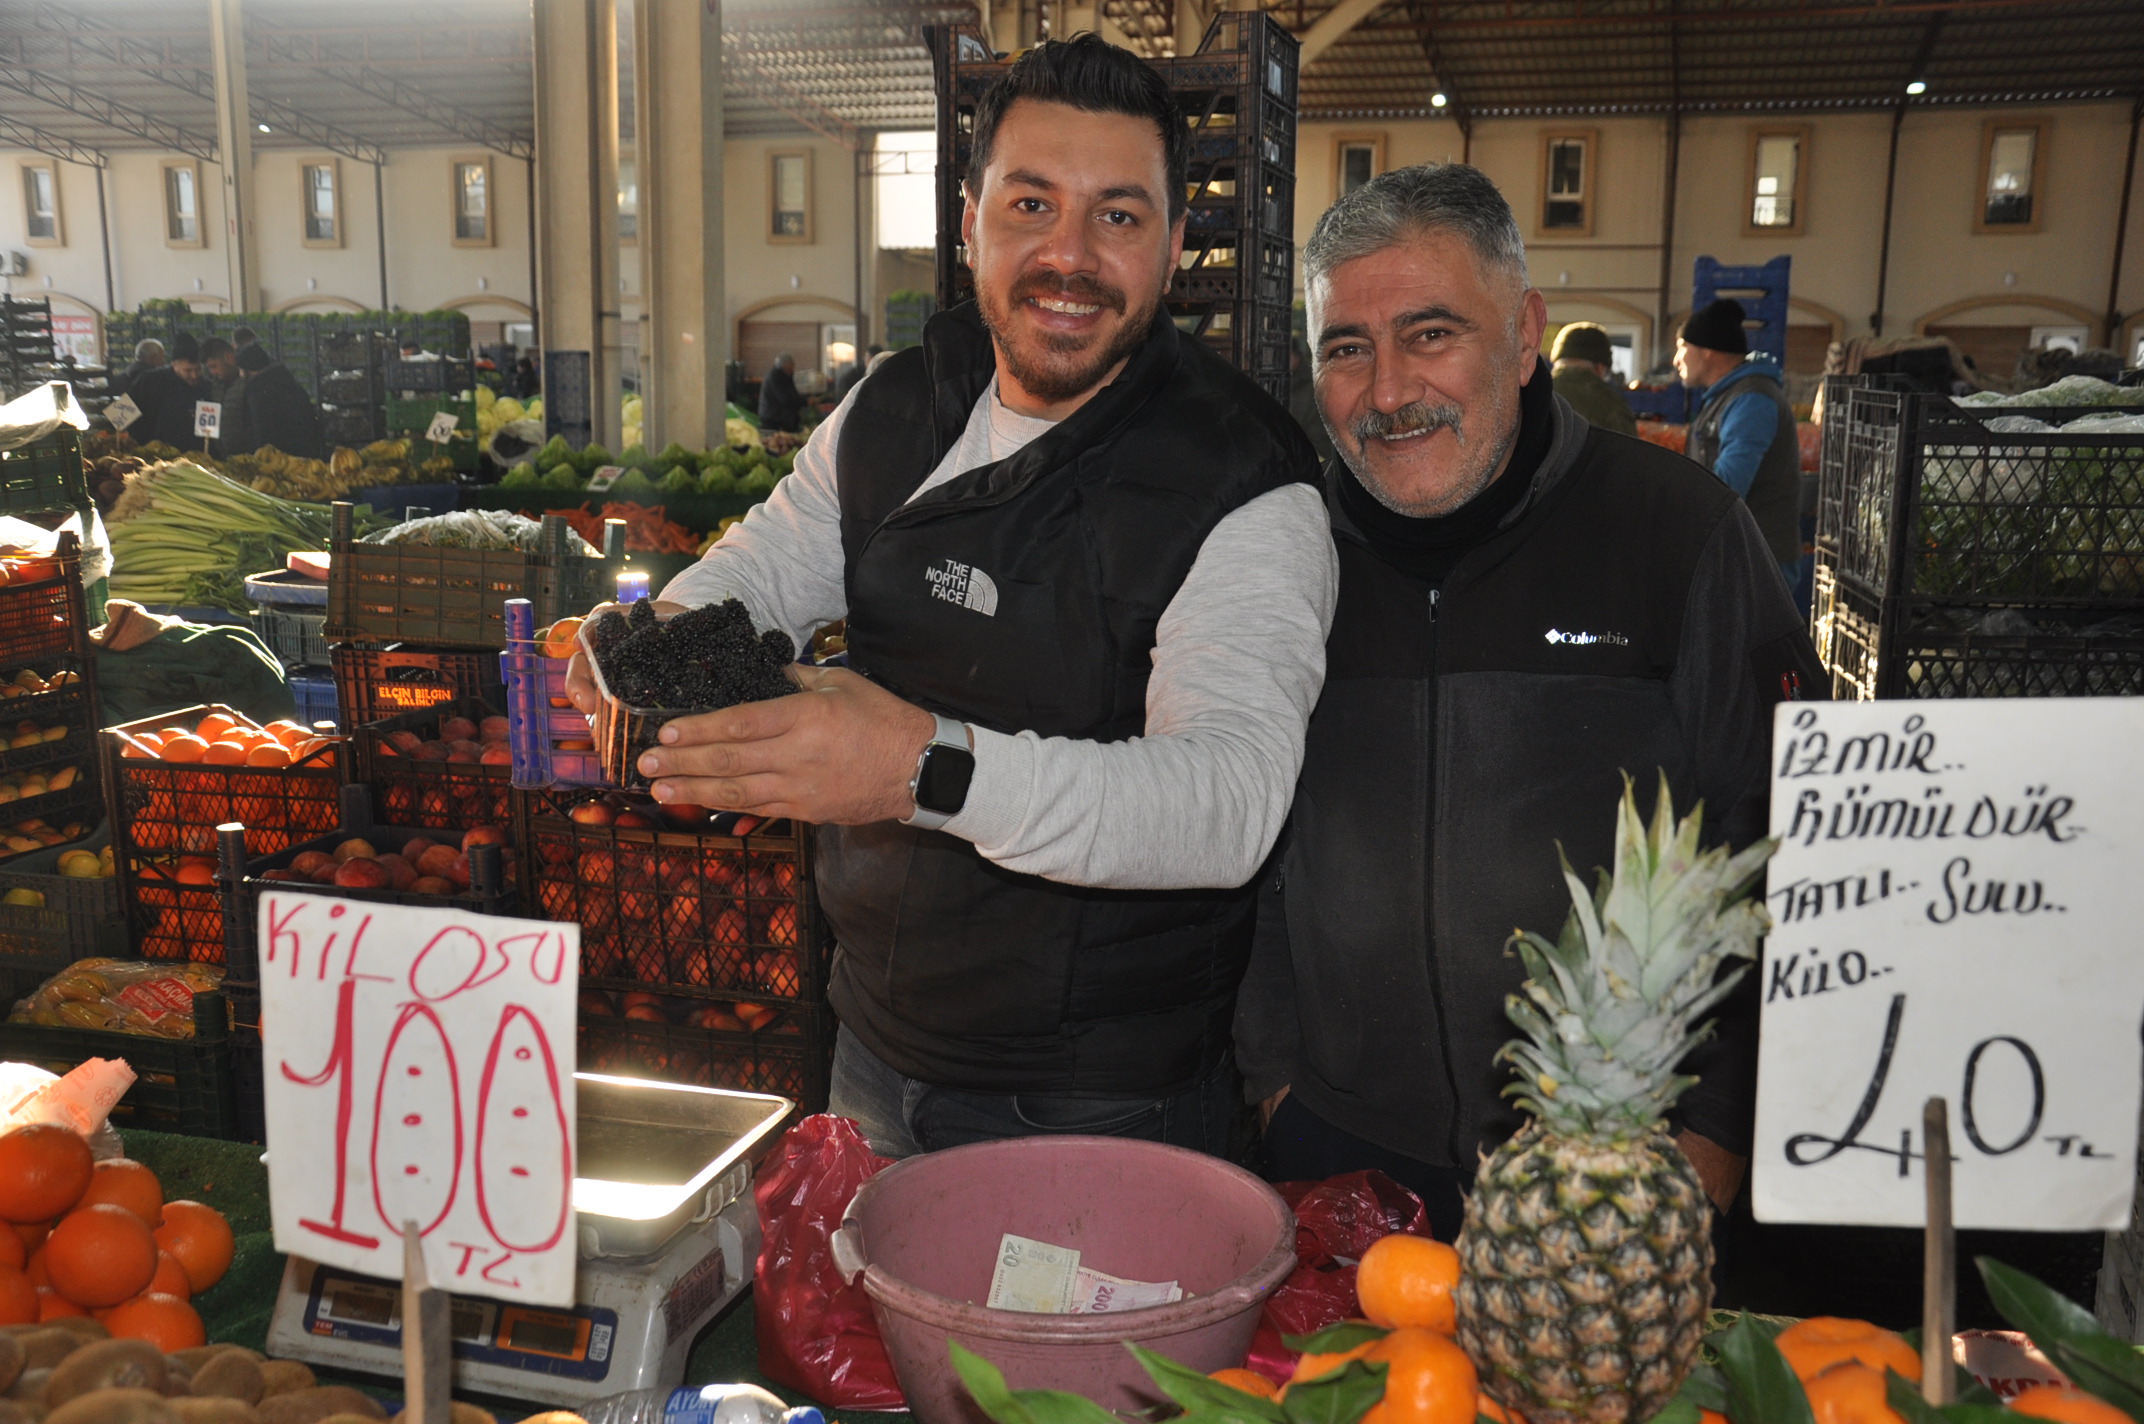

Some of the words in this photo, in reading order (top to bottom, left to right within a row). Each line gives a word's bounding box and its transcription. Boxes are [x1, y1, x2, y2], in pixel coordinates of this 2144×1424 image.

[924, 566, 967, 592] NORTH
[945, 559, 970, 578] THE
[931, 584, 965, 606] FACE
[1560, 631, 1629, 646] Columbia
[1784, 993, 2045, 1180] 40
[280, 979, 573, 1252] 100
[1003, 1240, 1023, 1268] 20
[1091, 1285, 1116, 1311] 200
